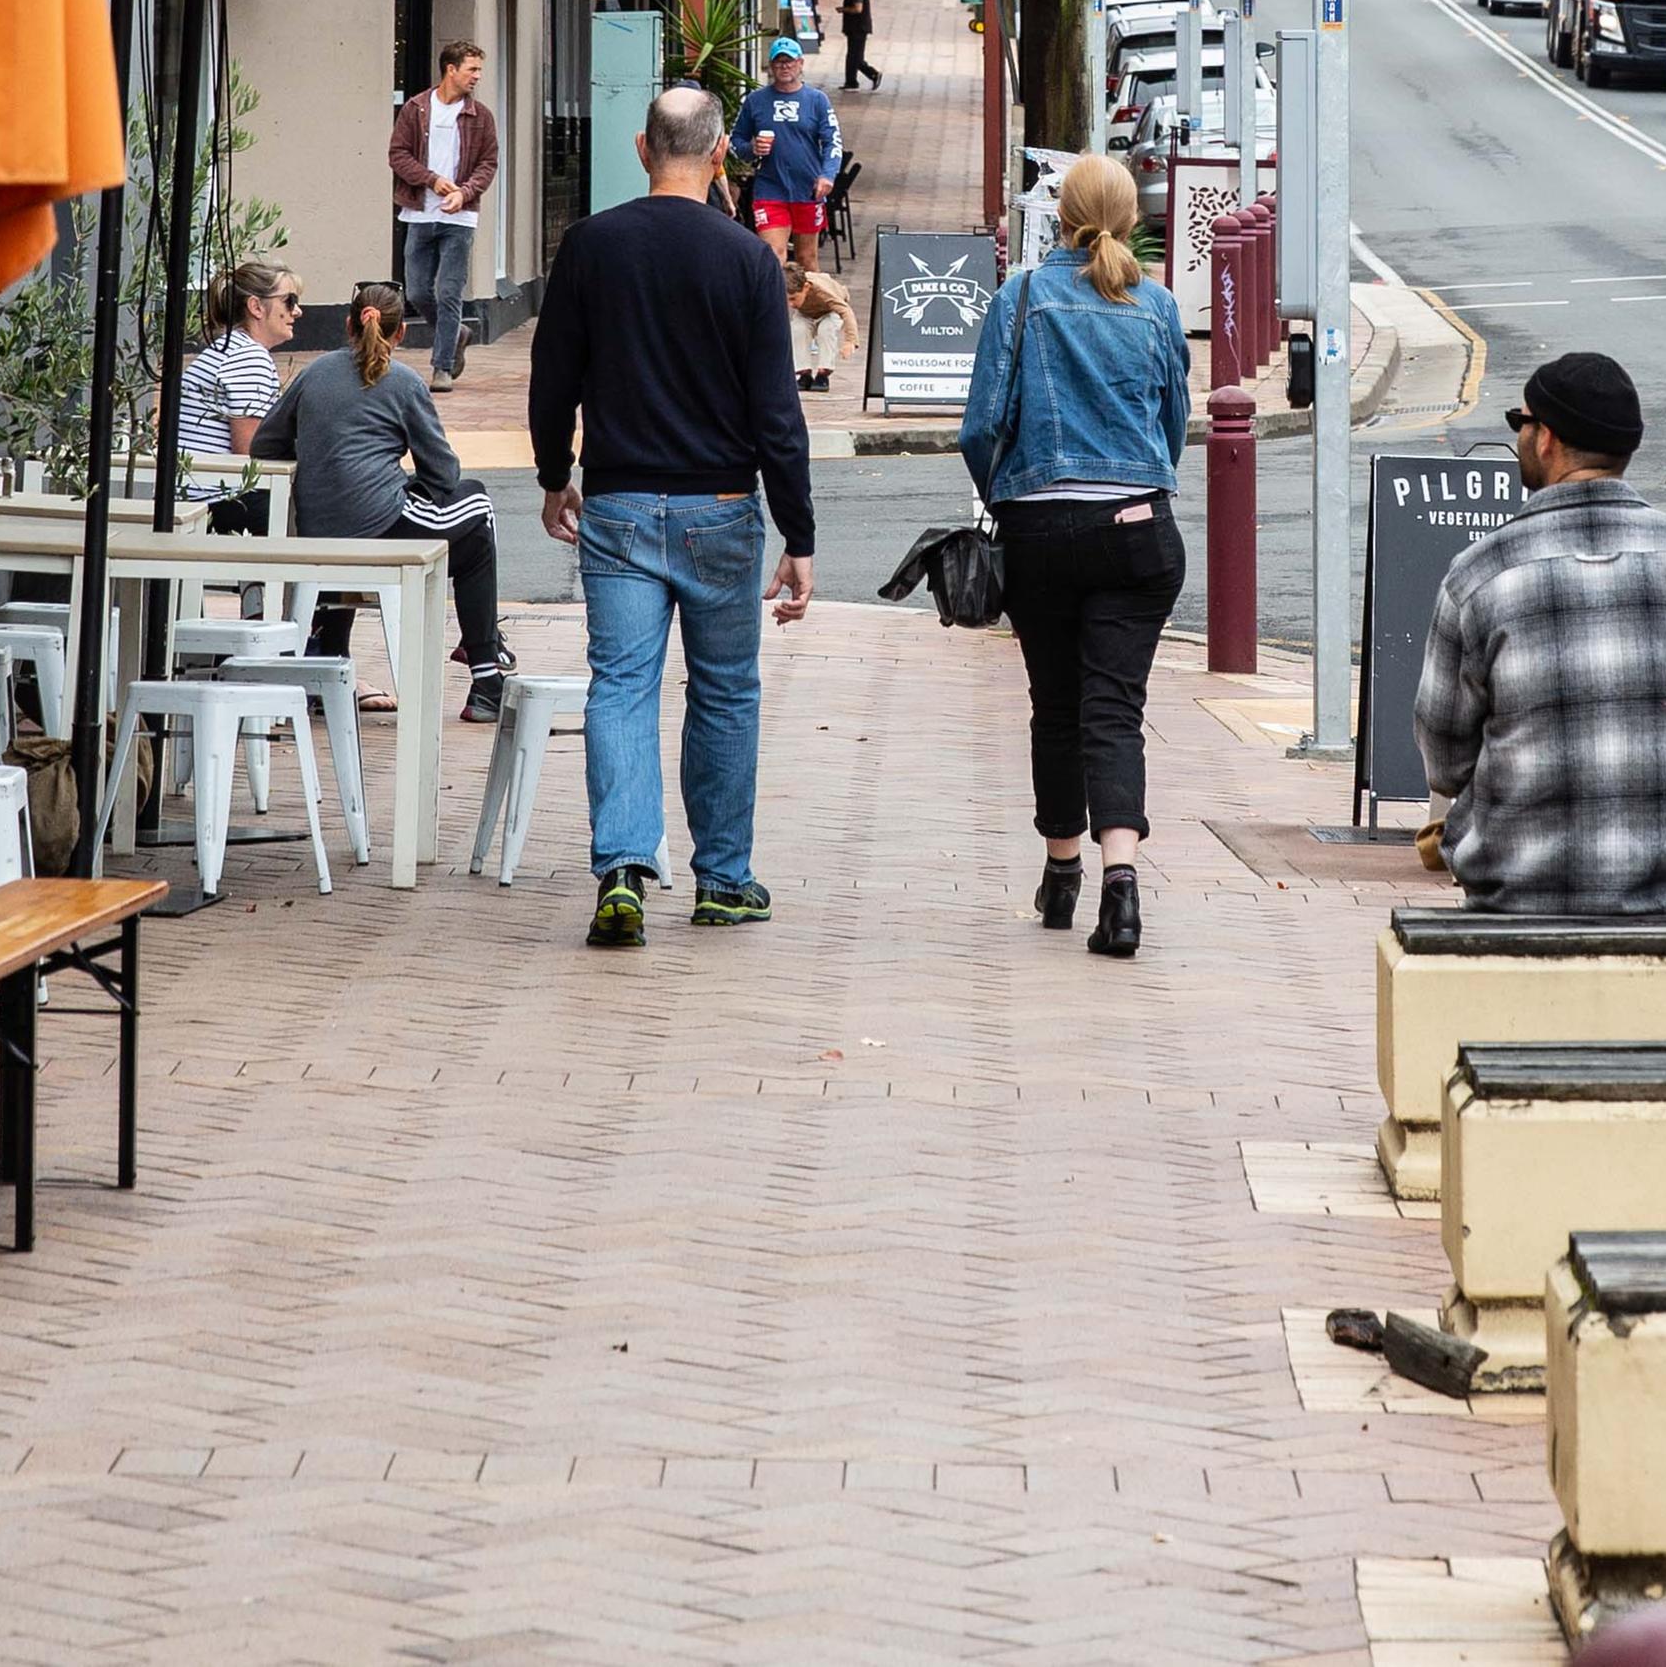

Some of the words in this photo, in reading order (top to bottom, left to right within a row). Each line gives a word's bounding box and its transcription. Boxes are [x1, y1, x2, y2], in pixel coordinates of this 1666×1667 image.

[911, 282, 938, 294] DUKE
[949, 283, 969, 294] CO.
[921, 326, 964, 336] MILTON
[891, 359, 952, 368] WHOLESOME
[899, 384, 935, 392] COFFEE
